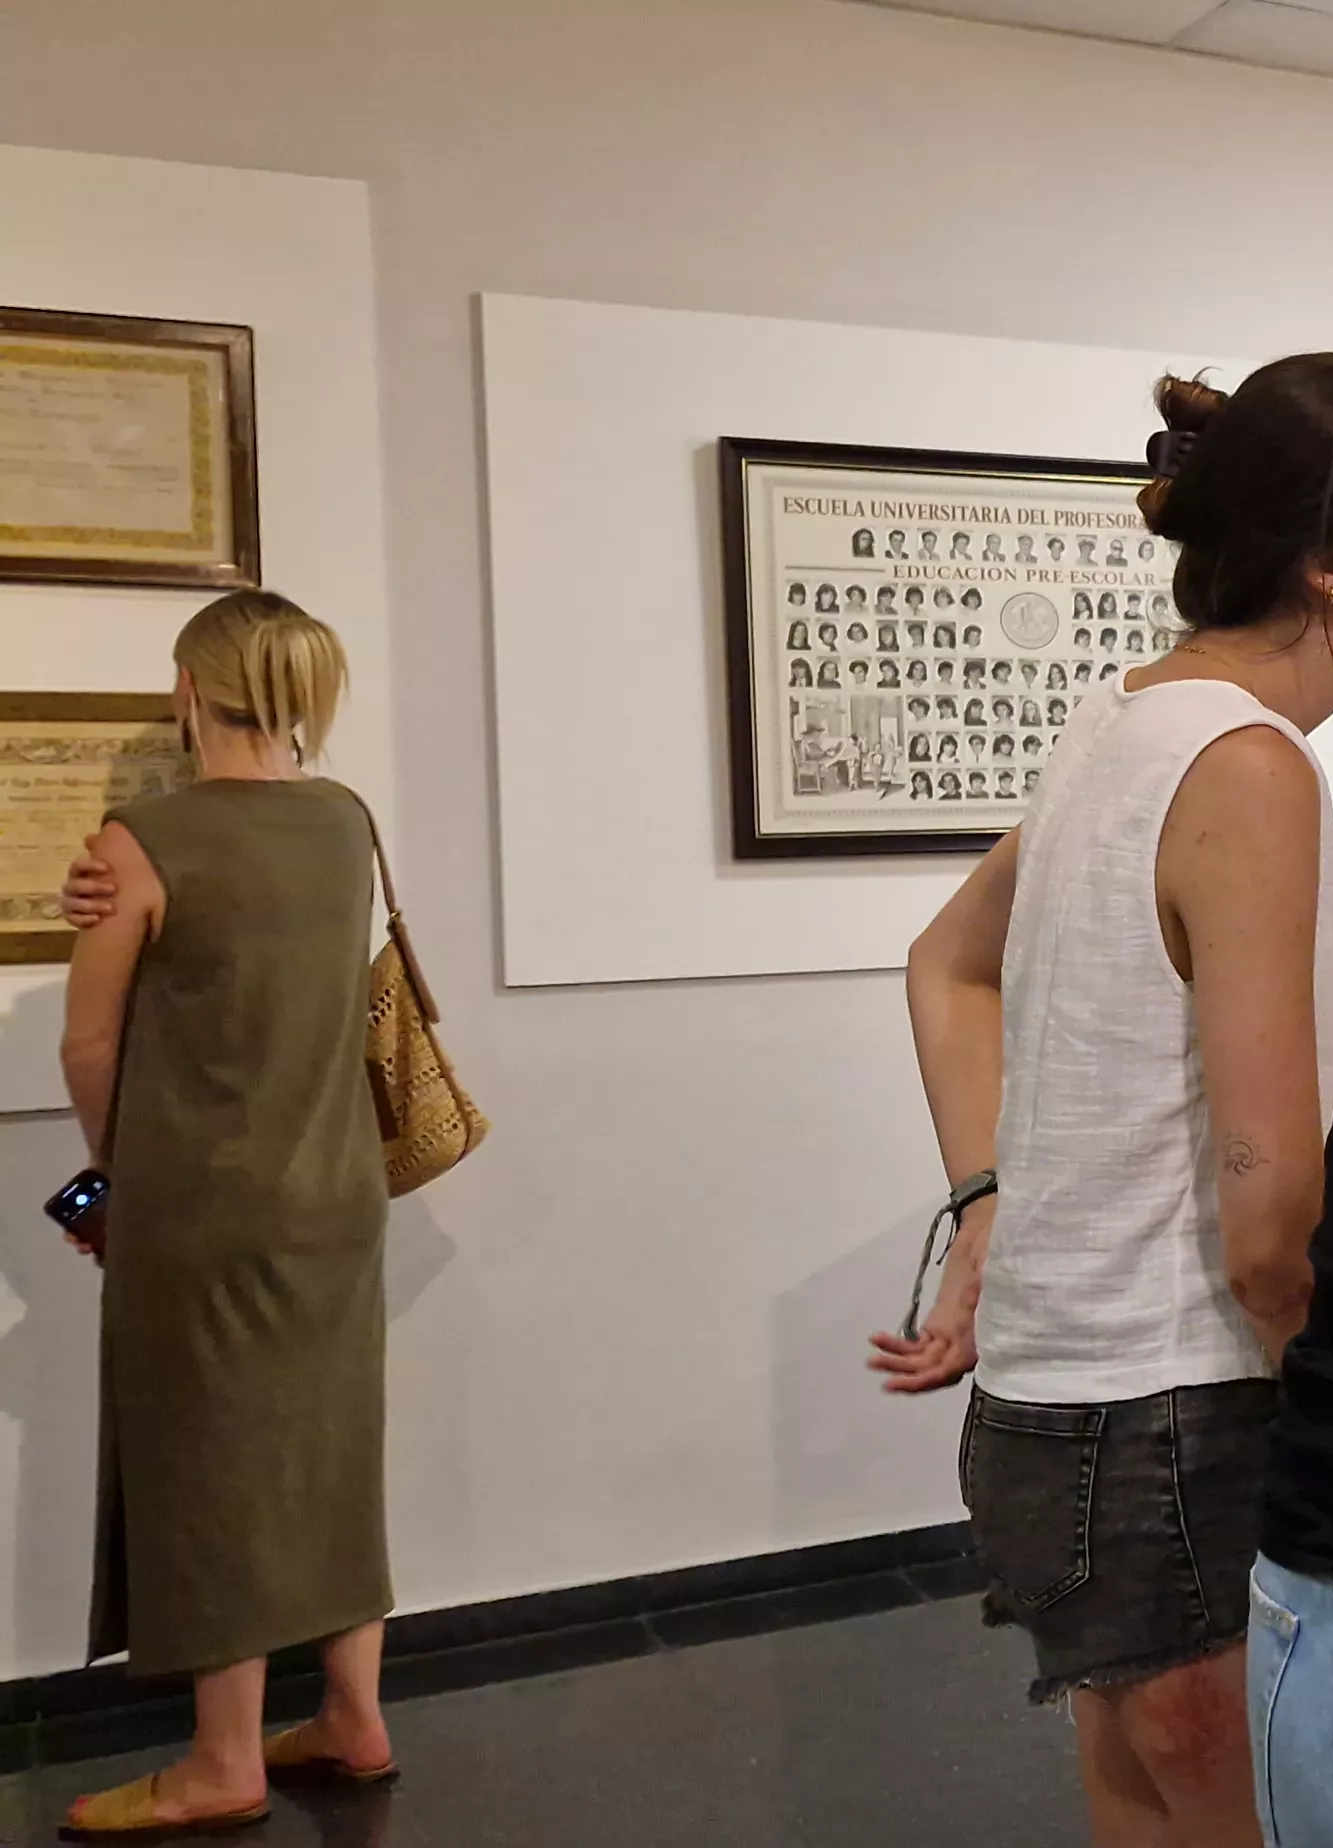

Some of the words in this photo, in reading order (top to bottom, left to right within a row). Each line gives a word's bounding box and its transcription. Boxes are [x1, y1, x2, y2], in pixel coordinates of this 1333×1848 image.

[783, 496, 865, 518] ESCUELA
[871, 499, 1012, 524] UNIVERSITARIA
[1017, 507, 1049, 526] DEL
[893, 564, 1017, 582] EDUCACION
